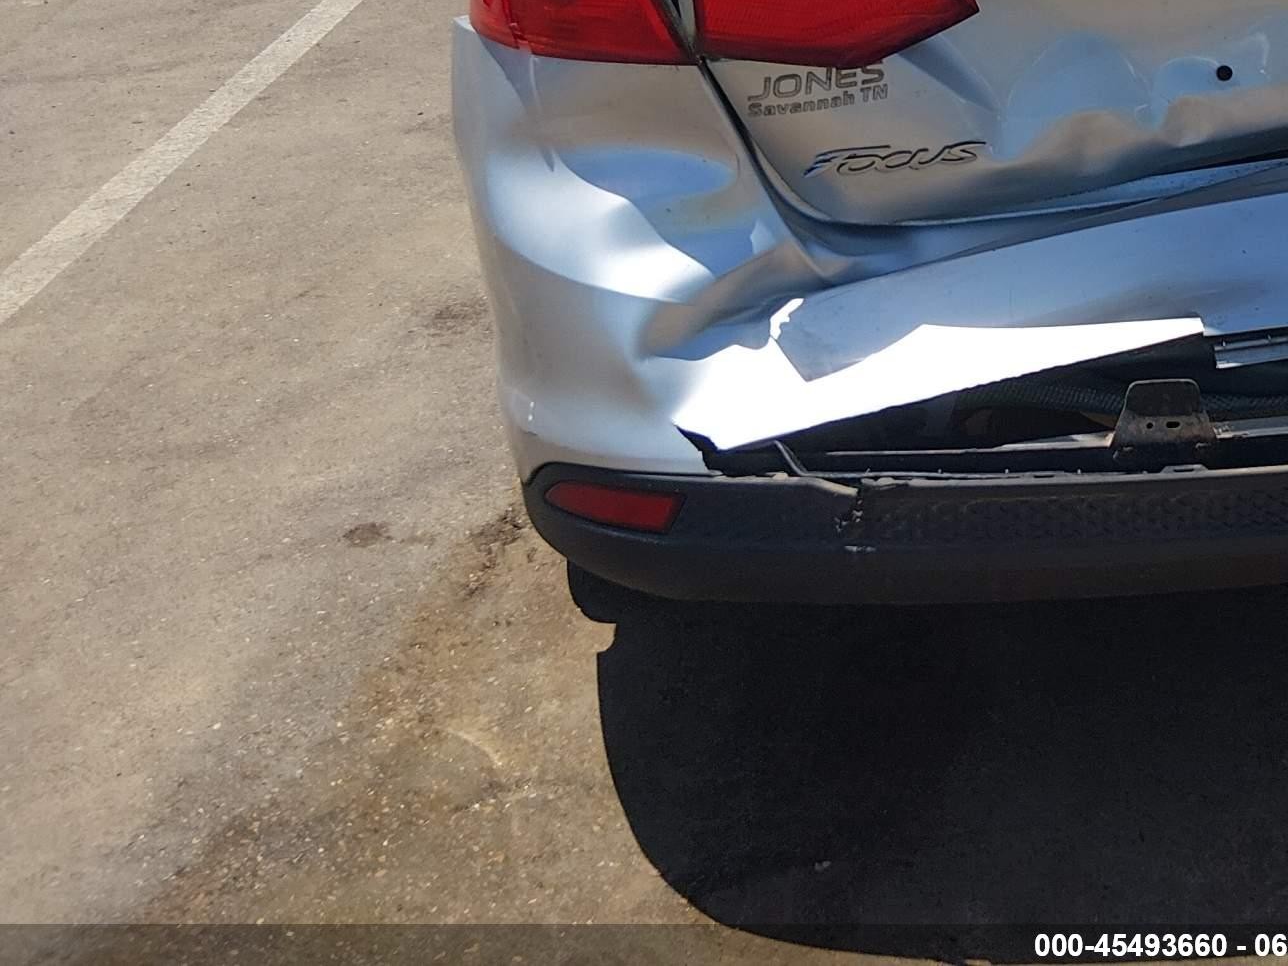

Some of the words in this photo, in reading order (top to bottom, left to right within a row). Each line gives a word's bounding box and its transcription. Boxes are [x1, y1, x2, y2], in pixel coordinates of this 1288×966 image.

[747, 66, 885, 101] JONES
[747, 90, 856, 117] Savannah
[860, 83, 888, 102] TN
